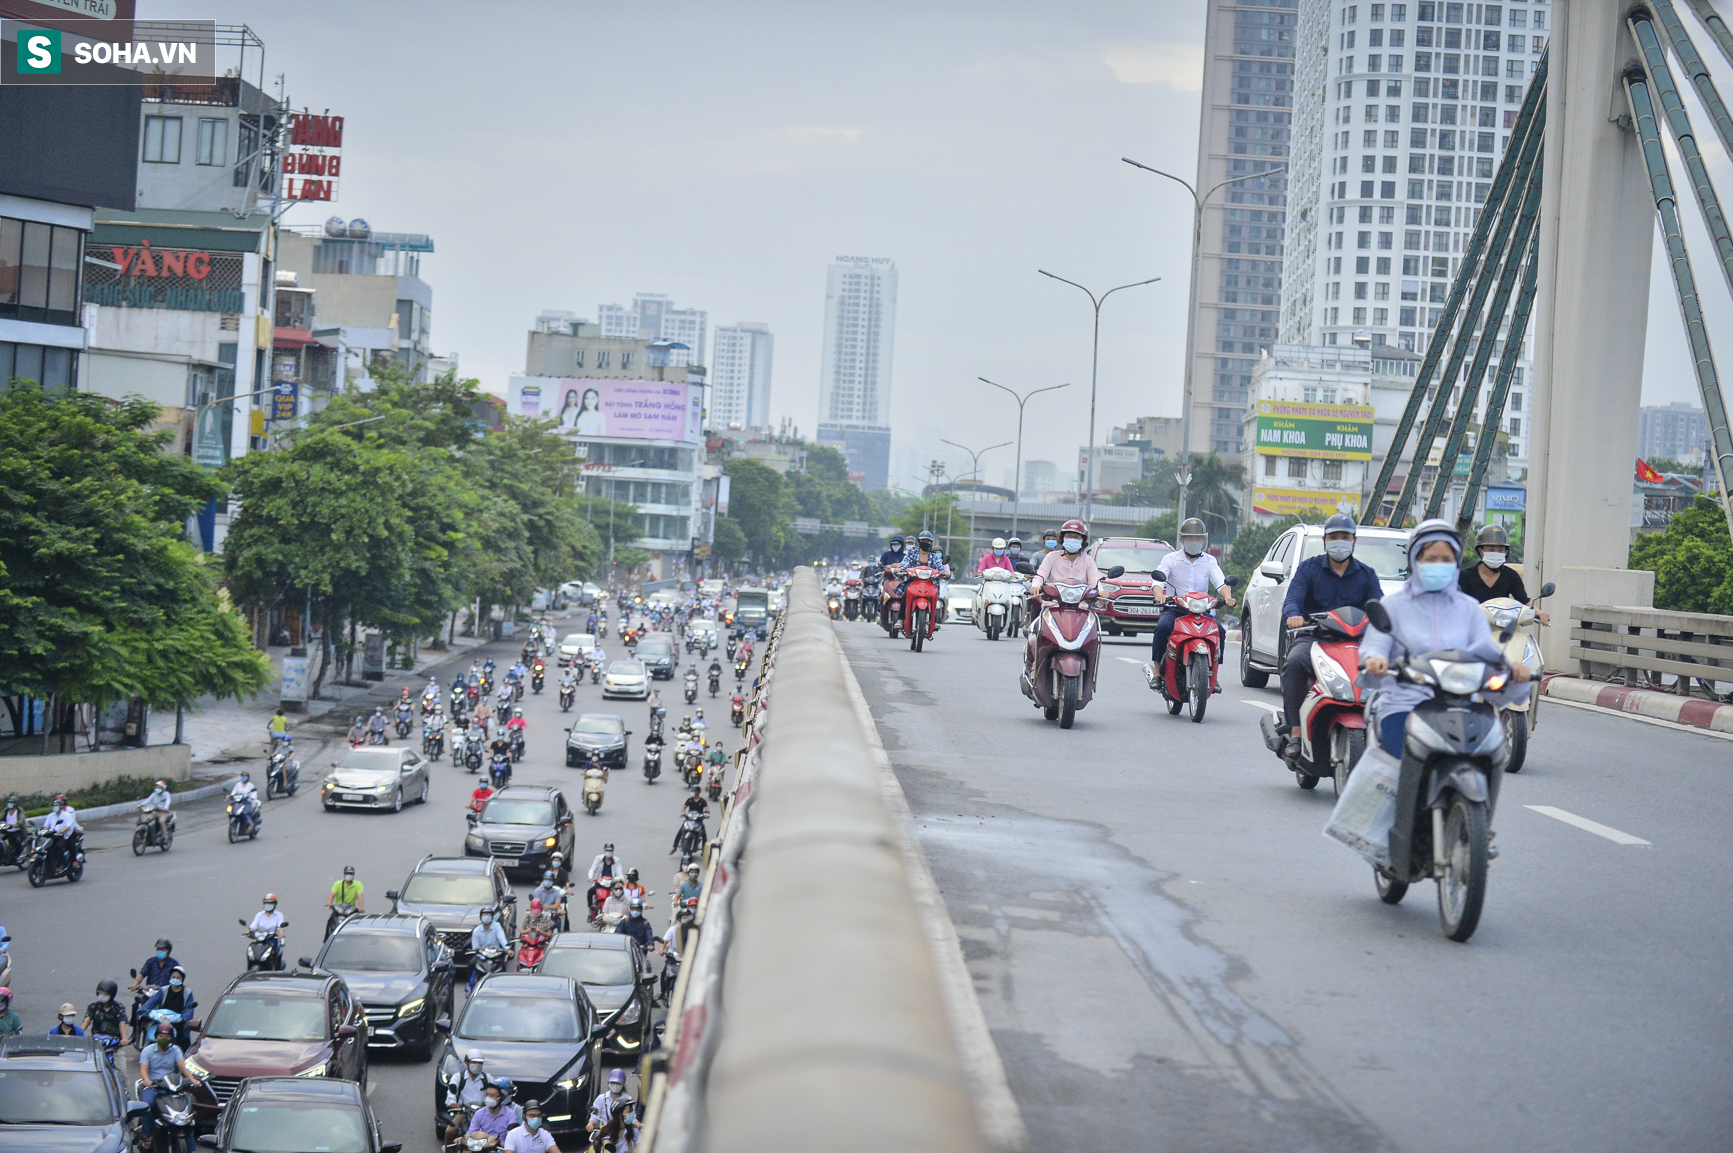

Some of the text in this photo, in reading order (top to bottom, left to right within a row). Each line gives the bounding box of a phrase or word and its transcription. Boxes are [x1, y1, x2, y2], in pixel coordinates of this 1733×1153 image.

[287, 178, 332, 201] LAN
[112, 239, 212, 280] VÀNG
[836, 255, 869, 263] HOANG
[1337, 424, 1358, 432] KHÁM
[1261, 429, 1306, 444] NAM KHOA
[1325, 433, 1367, 449] PHỤ KHOA
